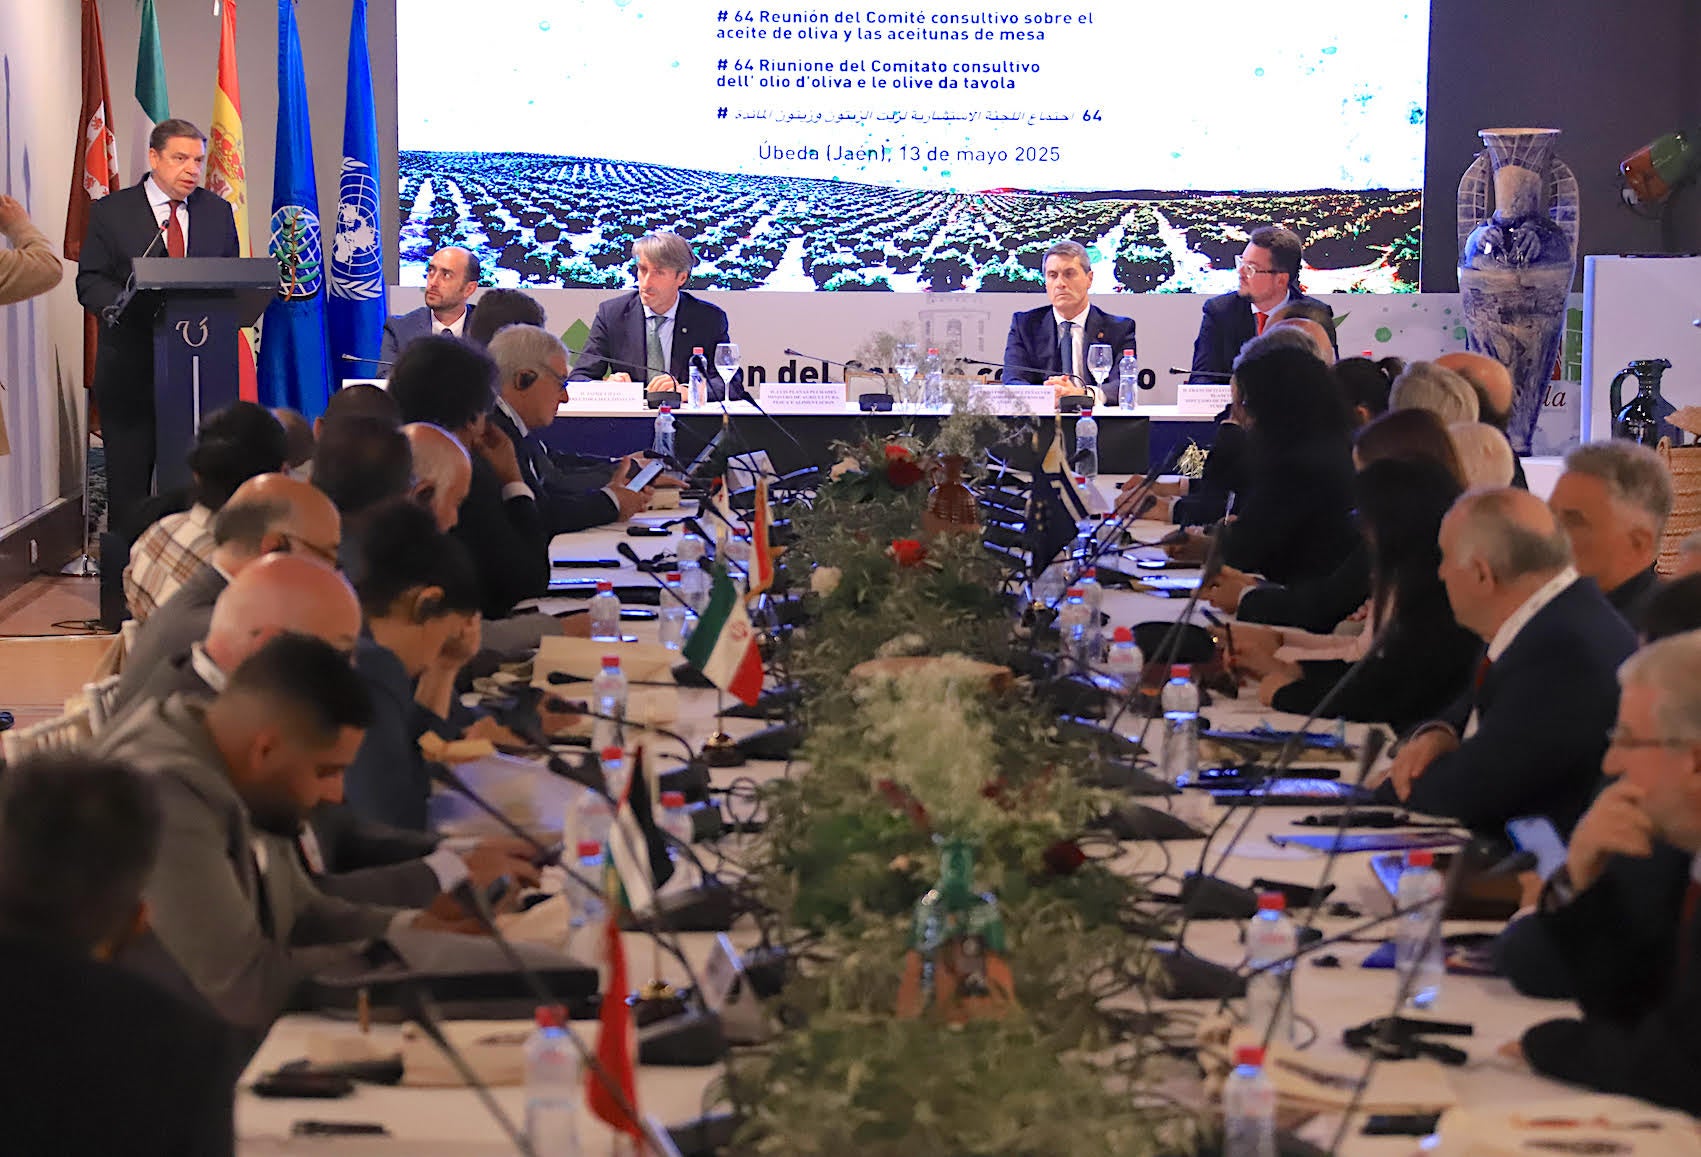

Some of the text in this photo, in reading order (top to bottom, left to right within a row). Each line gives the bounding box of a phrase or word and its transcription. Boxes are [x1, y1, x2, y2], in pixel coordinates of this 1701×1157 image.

[717, 9, 1093, 24] # 64 Reunión del Comité consultivo sobre el
[716, 26, 1045, 43] aceite de oliva y las aceitunas de mesa
[717, 58, 1040, 73] # 64 Riunione del Comitato consultivo
[716, 75, 1016, 89] dell' olio d'oliva e le olive da tavola
[1082, 109, 1102, 122] 64
[759, 140, 1061, 166] Úbeda (Jaén), 13 de mayo 2025
